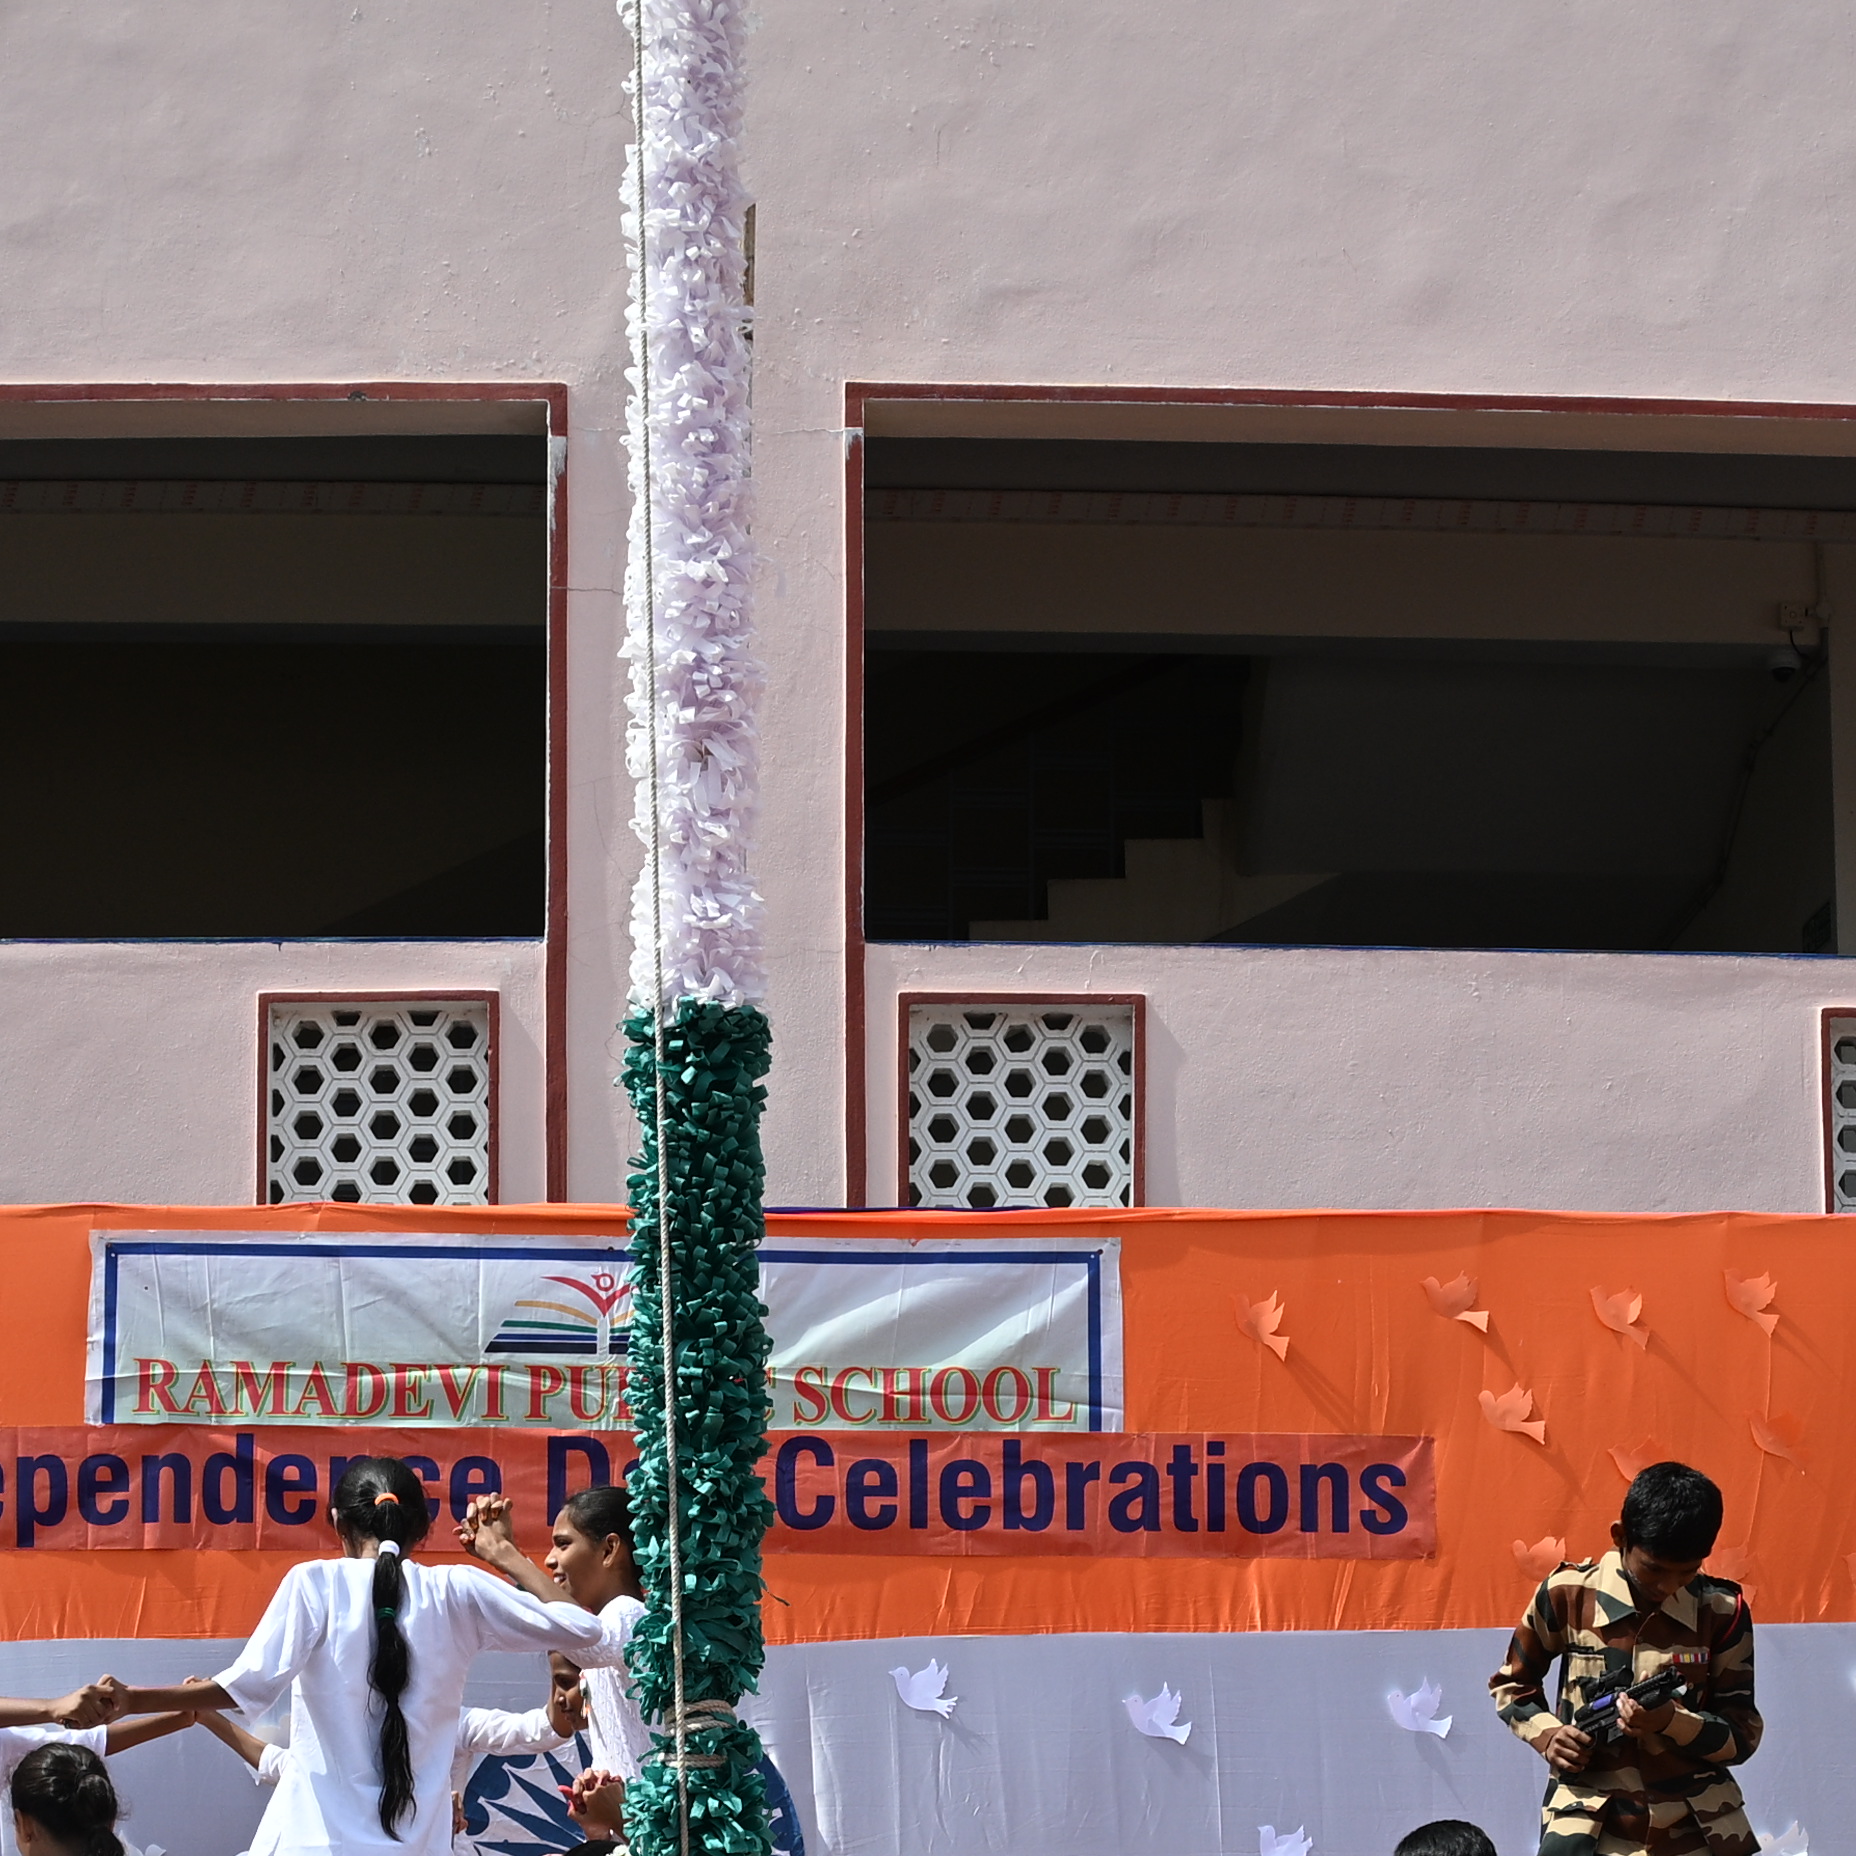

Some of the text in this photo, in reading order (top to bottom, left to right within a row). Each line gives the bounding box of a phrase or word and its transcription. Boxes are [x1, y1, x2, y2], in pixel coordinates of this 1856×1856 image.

[132, 1356, 510, 1422] RAMADEVI
[793, 1365, 1078, 1425] SCHOOL
[775, 1435, 1408, 1535] Celebrations
